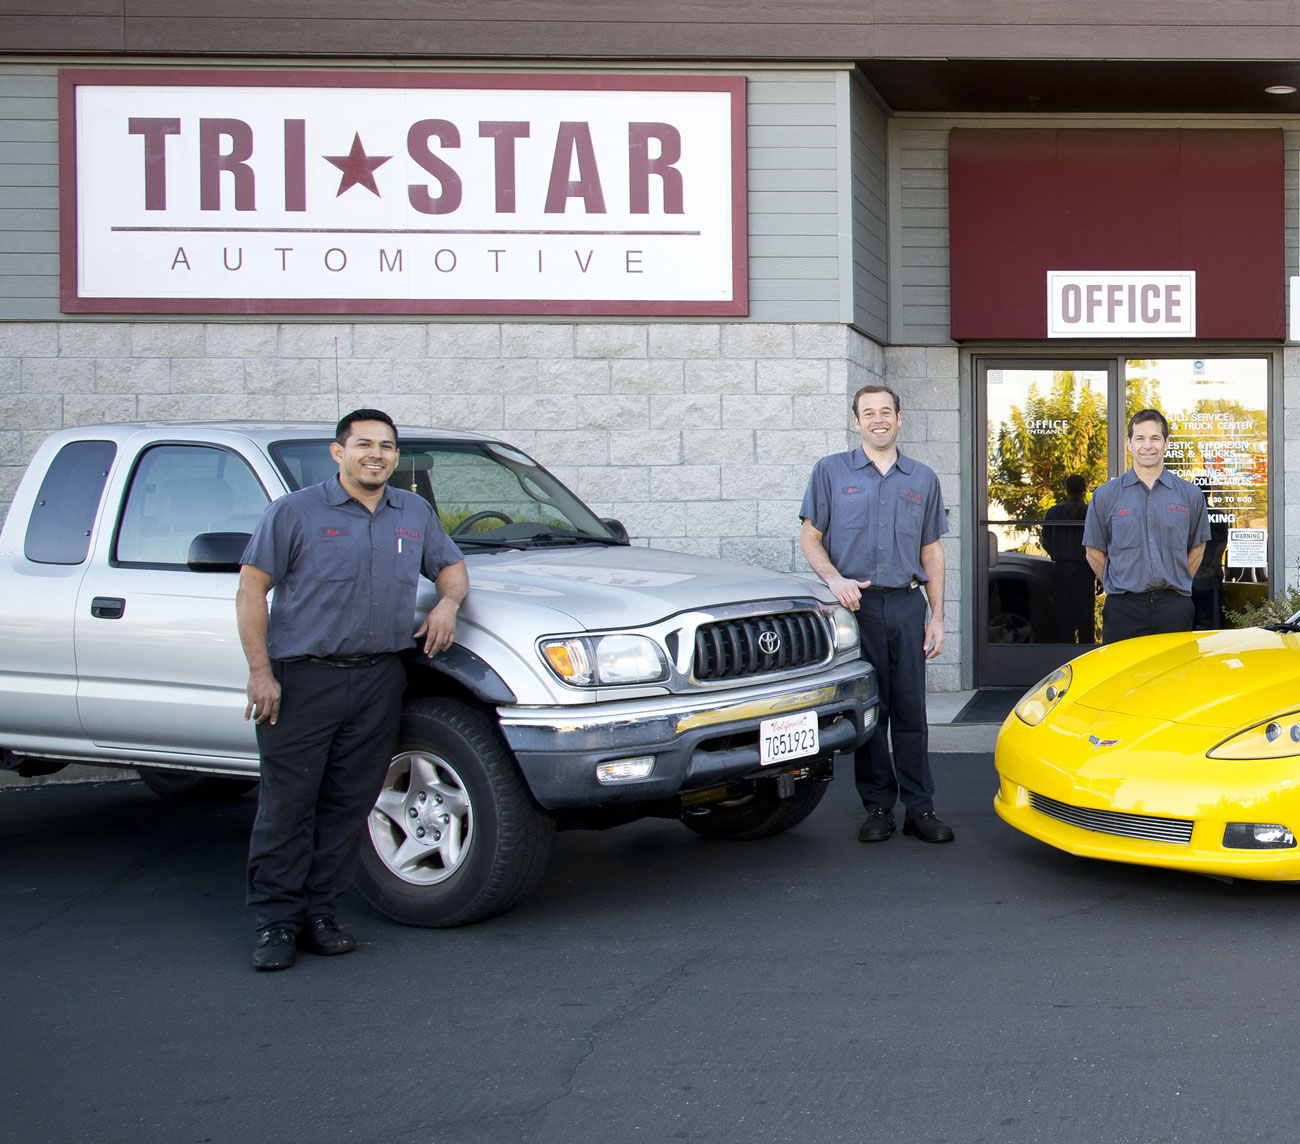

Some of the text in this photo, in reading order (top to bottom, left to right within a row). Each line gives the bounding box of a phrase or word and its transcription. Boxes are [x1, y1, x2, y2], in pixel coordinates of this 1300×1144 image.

[128, 117, 685, 214] TRI STAR
[171, 247, 644, 274] AUTOMOTIVE
[1061, 284, 1181, 324] OFFICE
[1191, 413, 1229, 421] SERVICE
[1025, 419, 1068, 429] OFFICE
[1171, 421, 1252, 430] & TRUCK CENTER
[1167, 441, 1194, 450] ESTIC
[1163, 450, 1185, 458] ARS
[1200, 449, 1236, 458] TRUCKS
[765, 728, 815, 757] 7G51923
